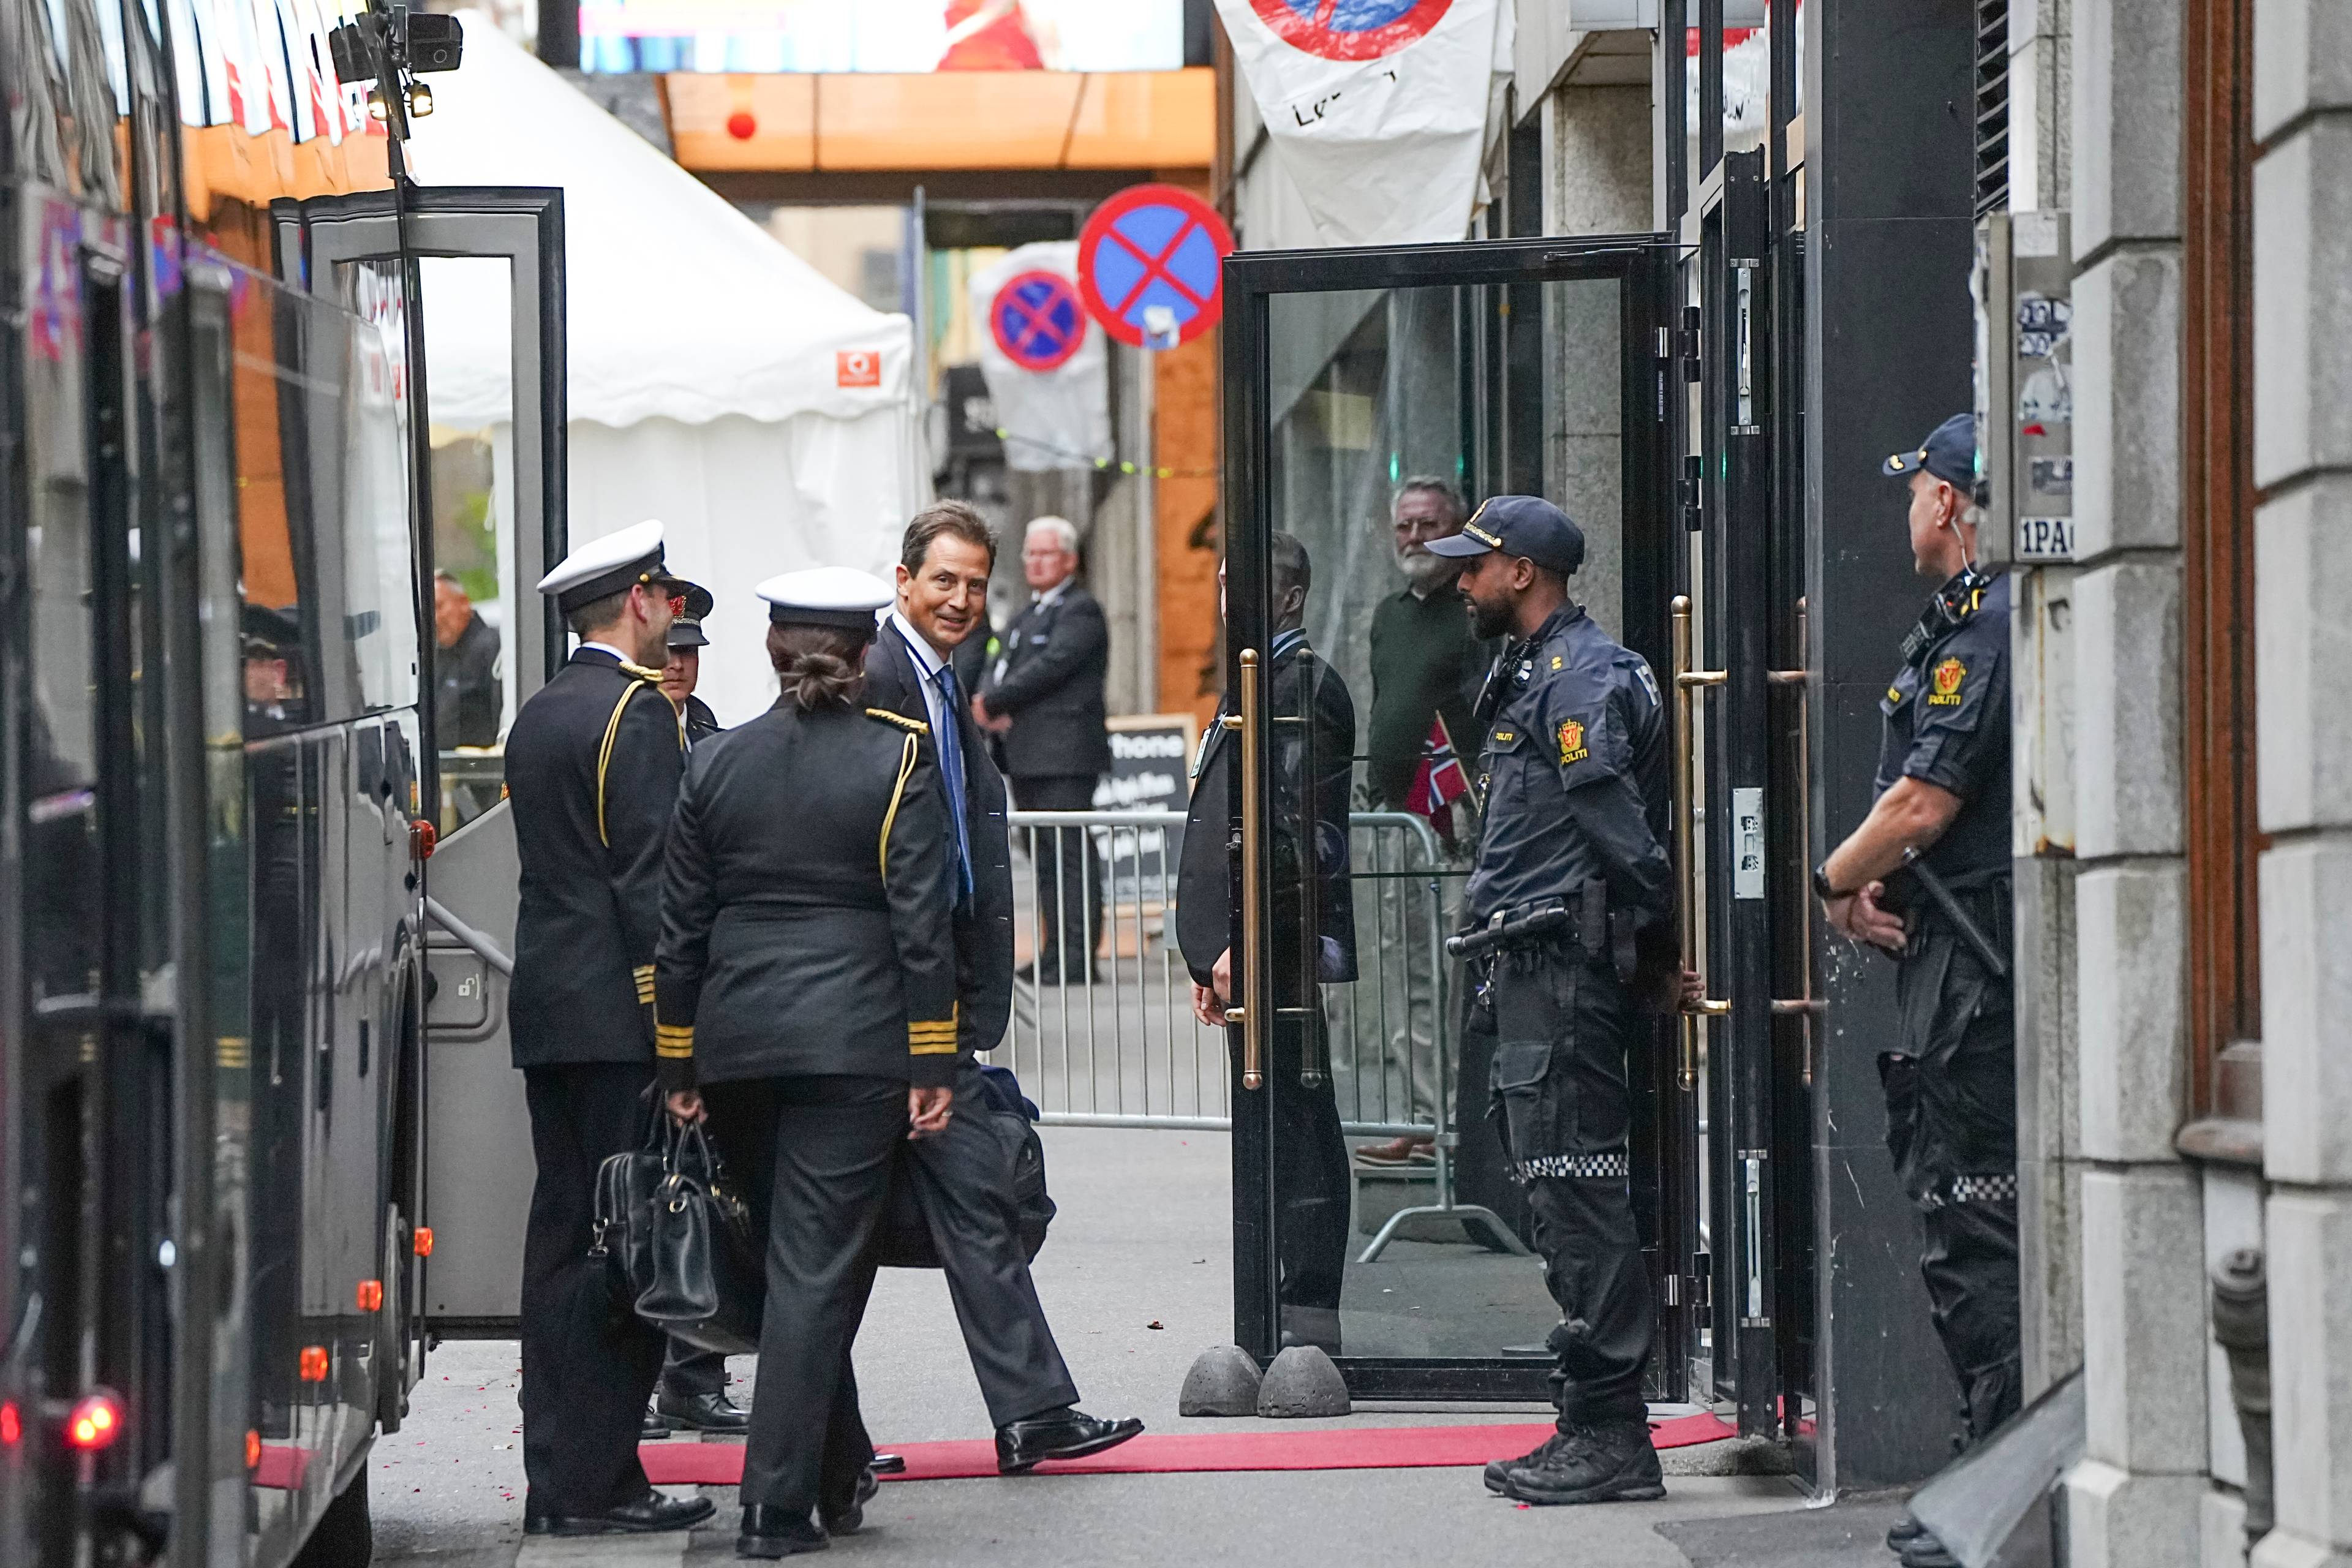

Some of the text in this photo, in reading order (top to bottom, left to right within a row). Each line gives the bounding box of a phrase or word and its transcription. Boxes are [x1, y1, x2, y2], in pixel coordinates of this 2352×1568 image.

[2024, 521, 2073, 552] 1PA
[1928, 695, 1961, 706] POLITI
[1561, 748, 1588, 765] POLITI
